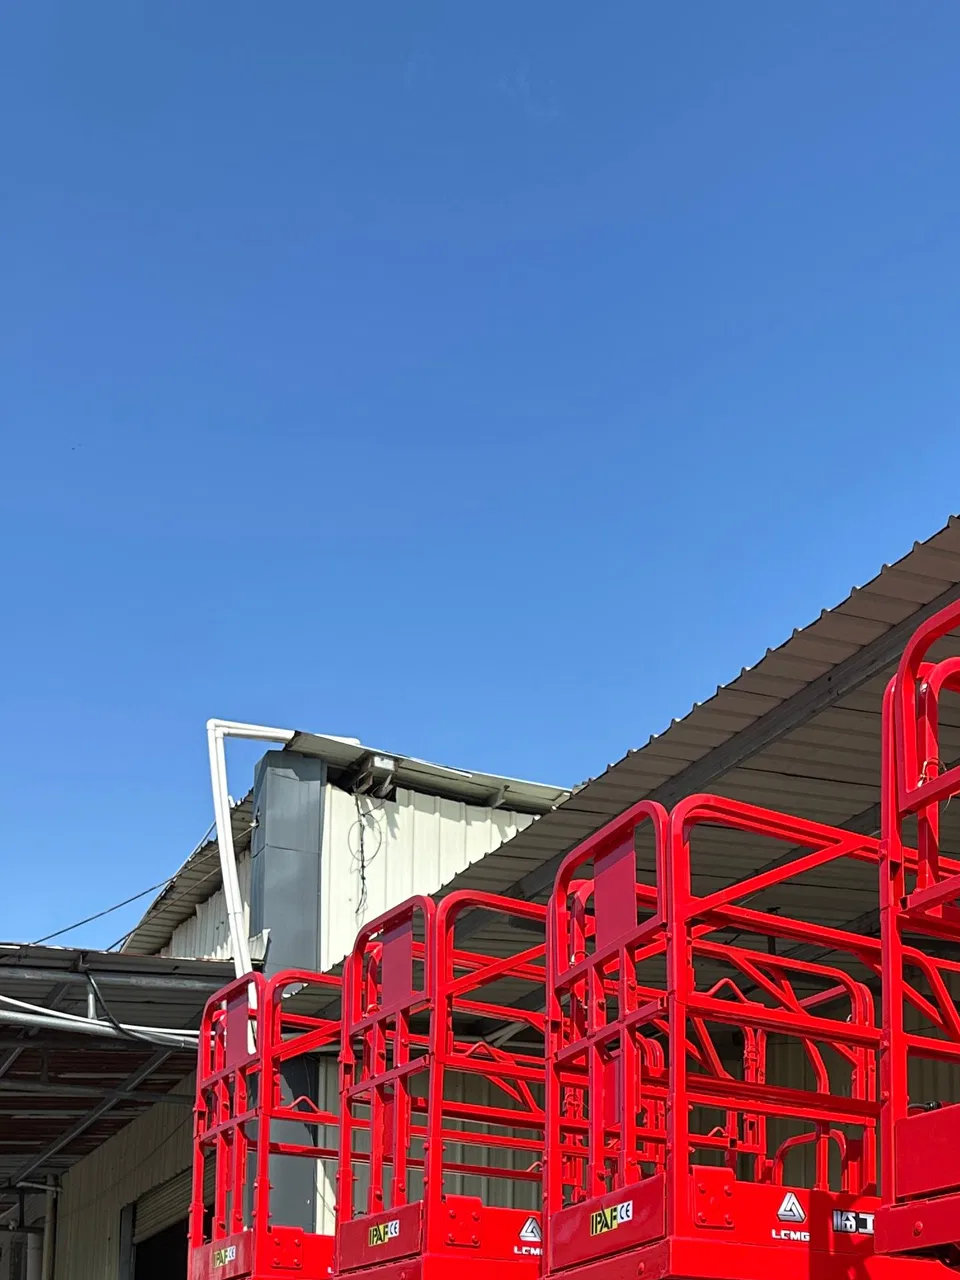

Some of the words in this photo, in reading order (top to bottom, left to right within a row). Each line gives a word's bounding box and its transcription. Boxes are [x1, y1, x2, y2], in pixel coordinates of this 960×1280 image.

[591, 1205, 618, 1235] IPAF
[771, 1228, 811, 1242] LCMG
[513, 1245, 543, 1256] LCM
